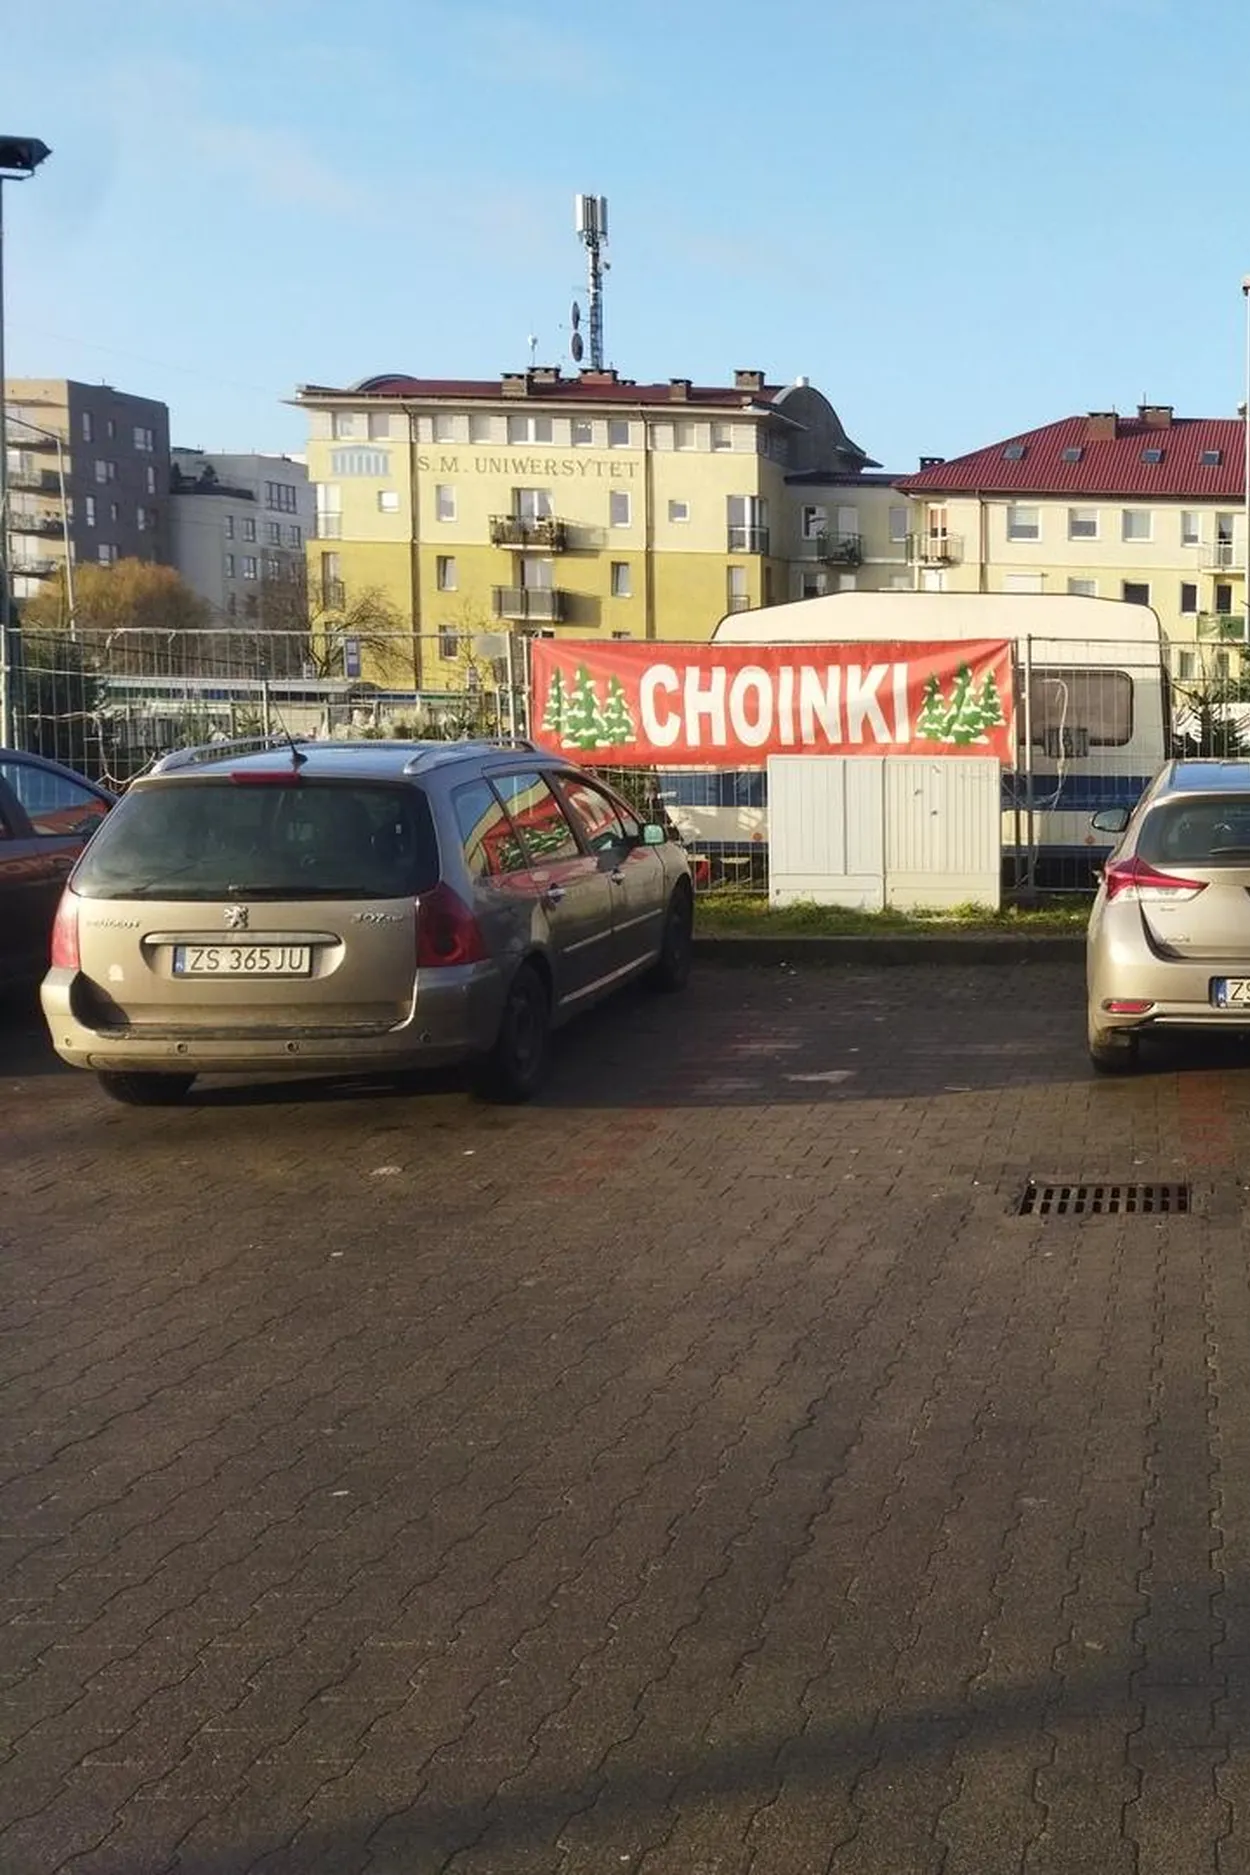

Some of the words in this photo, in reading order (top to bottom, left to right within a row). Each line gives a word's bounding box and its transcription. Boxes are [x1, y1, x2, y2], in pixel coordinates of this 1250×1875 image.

[474, 456, 640, 478] UNIWERSYTET
[639, 662, 911, 748] CHOINKI
[190, 948, 220, 970] ZS
[229, 948, 304, 971] 365JU
